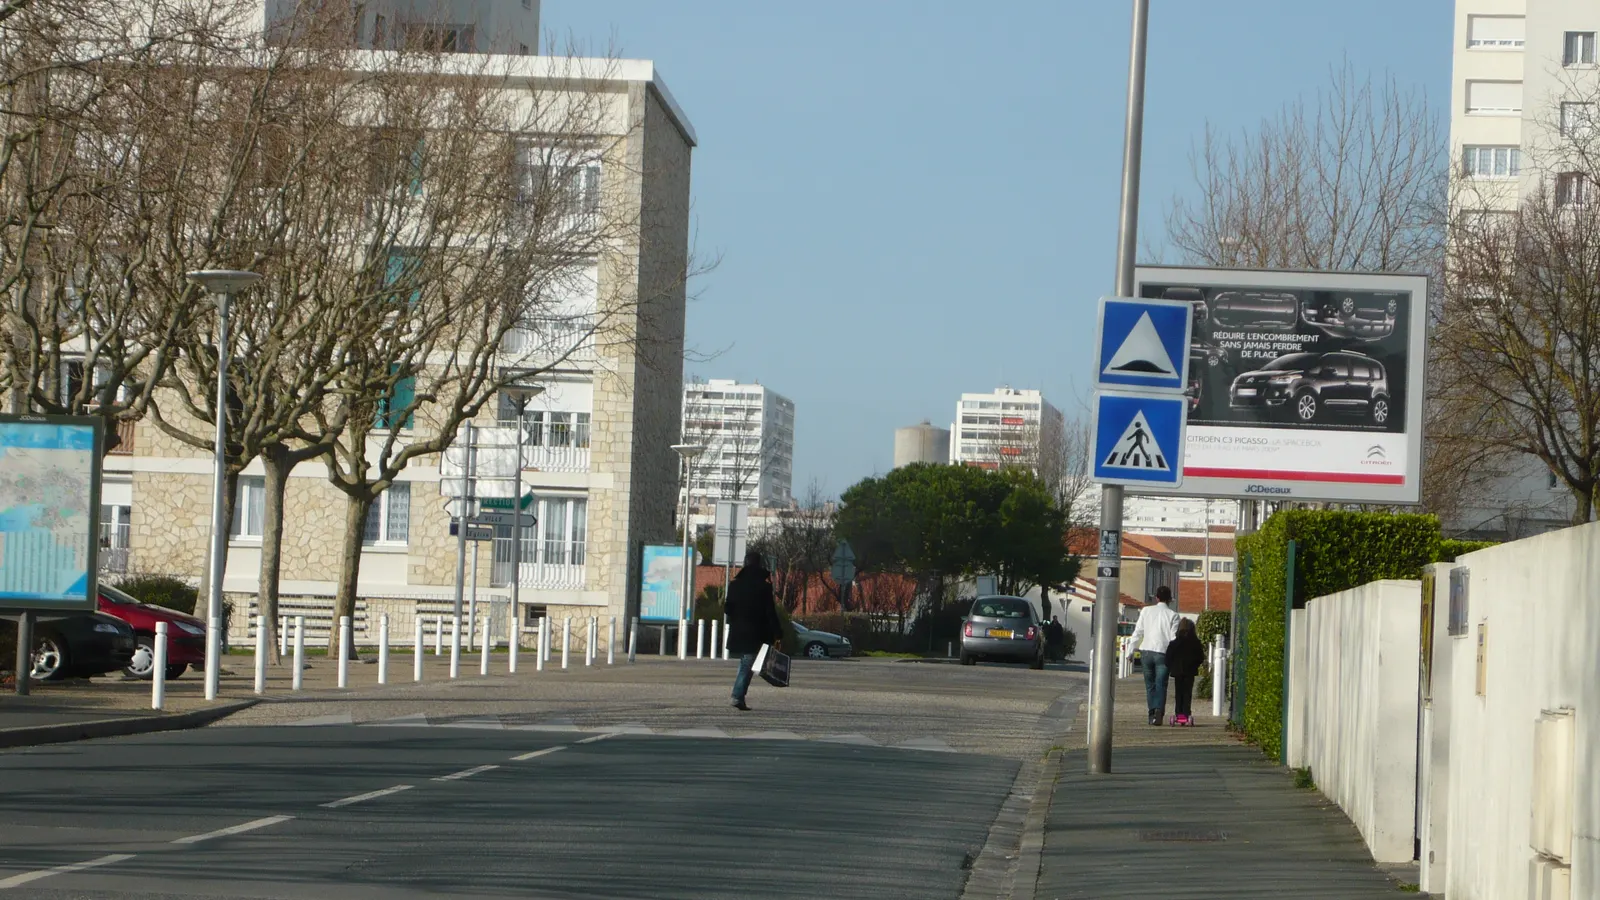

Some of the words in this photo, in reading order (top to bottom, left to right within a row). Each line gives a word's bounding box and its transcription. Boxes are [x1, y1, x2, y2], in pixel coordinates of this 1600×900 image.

[1213, 331, 1245, 340] RÉDUIRE
[1247, 332, 1320, 342] L'ENCOMBREMENT
[1220, 341, 1241, 349] SANS
[1243, 341, 1271, 350] JAMAIS
[1273, 342, 1302, 351] PERDRE
[1241, 350, 1252, 358] DE
[1253, 350, 1278, 359] PLACE
[1222, 436, 1233, 444] C3
[1245, 484, 1291, 494] JCDecaux
